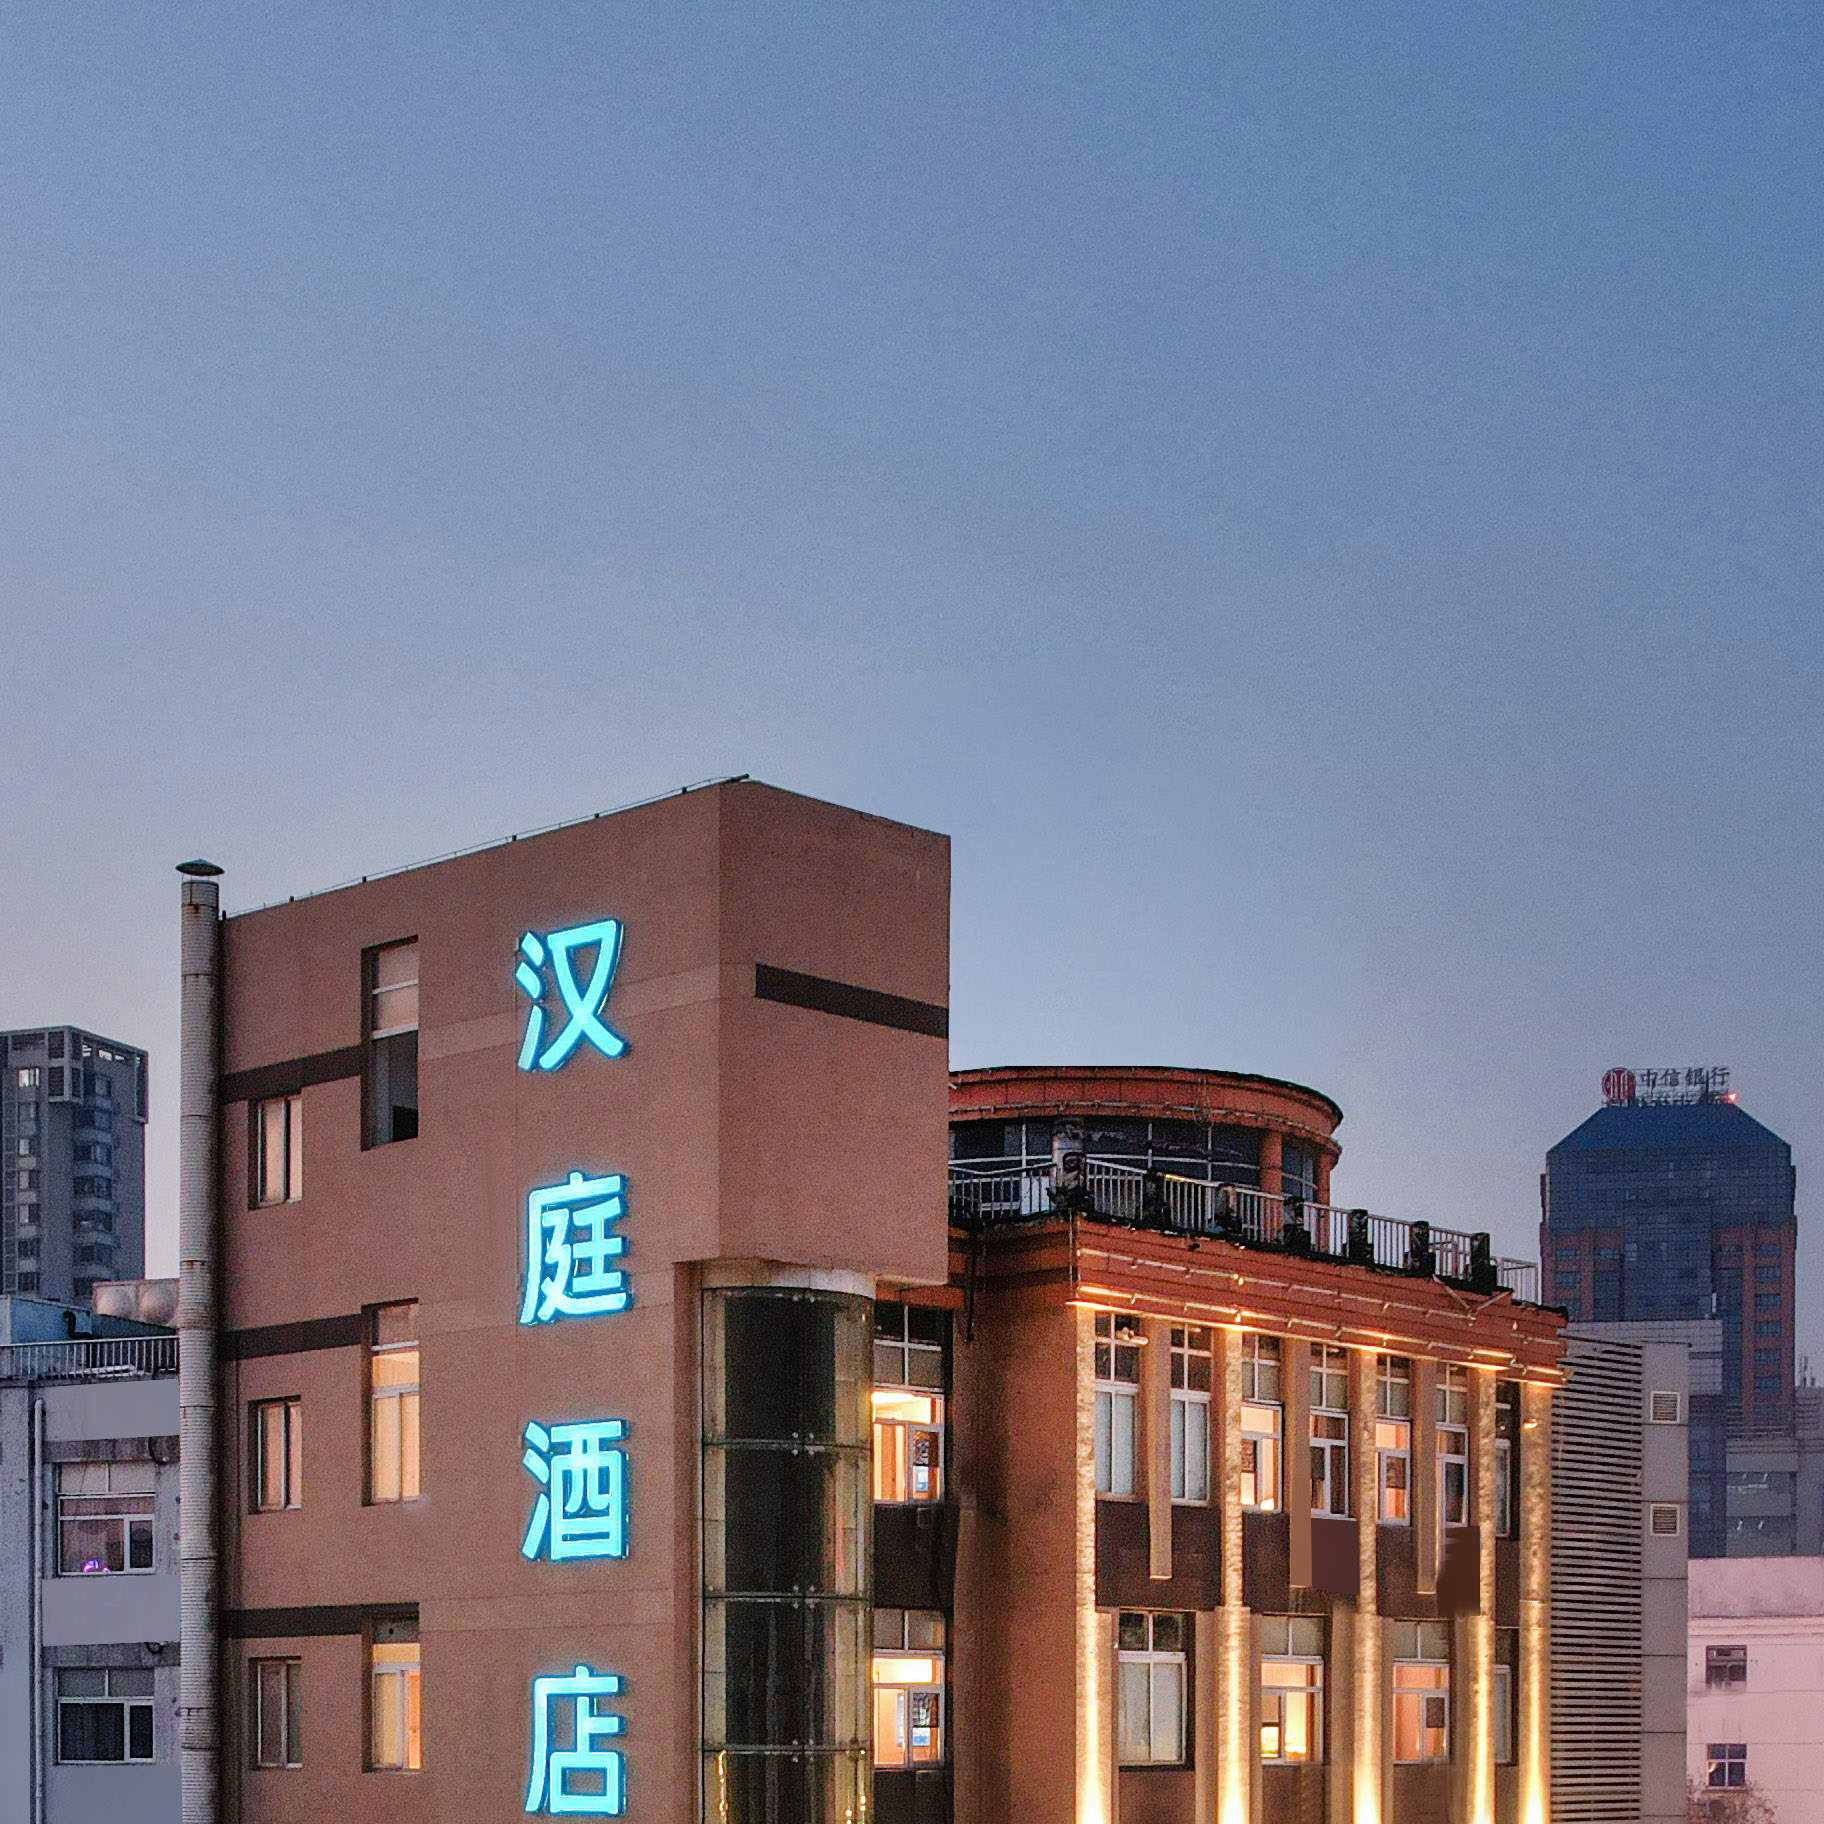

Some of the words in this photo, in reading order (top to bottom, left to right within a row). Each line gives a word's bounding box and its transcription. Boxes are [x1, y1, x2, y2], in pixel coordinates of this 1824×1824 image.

[1640, 1066, 1730, 1089] 中信银行
[514, 917, 629, 1816] 汉庭酒店
